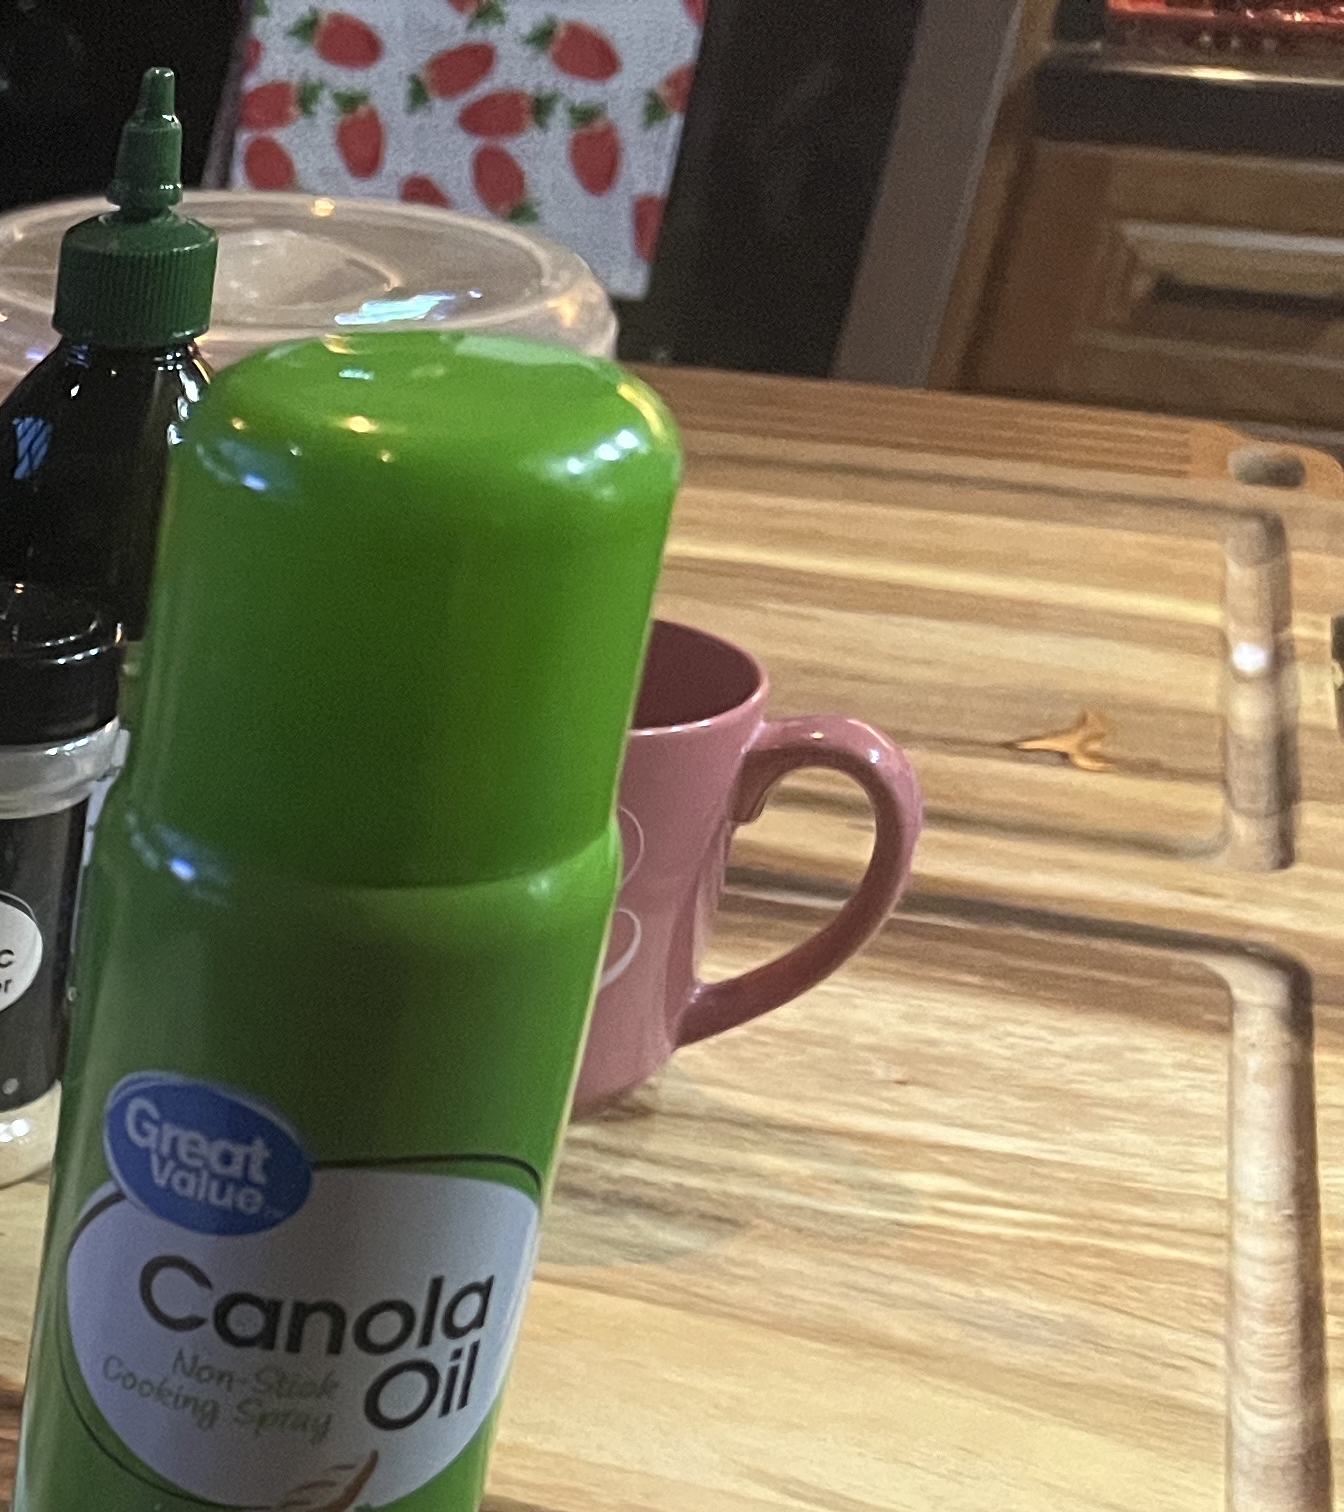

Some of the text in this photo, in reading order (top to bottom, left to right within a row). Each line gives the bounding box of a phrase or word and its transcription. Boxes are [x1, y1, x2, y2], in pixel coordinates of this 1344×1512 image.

[124, 1097, 272, 1186] Great
[149, 1155, 265, 1216] Value
[139, 1254, 495, 1356] Canola
[102, 1354, 333, 1447] Cooking Spray
[172, 1346, 340, 1399] Non-Stick
[364, 1340, 481, 1431] Oil
